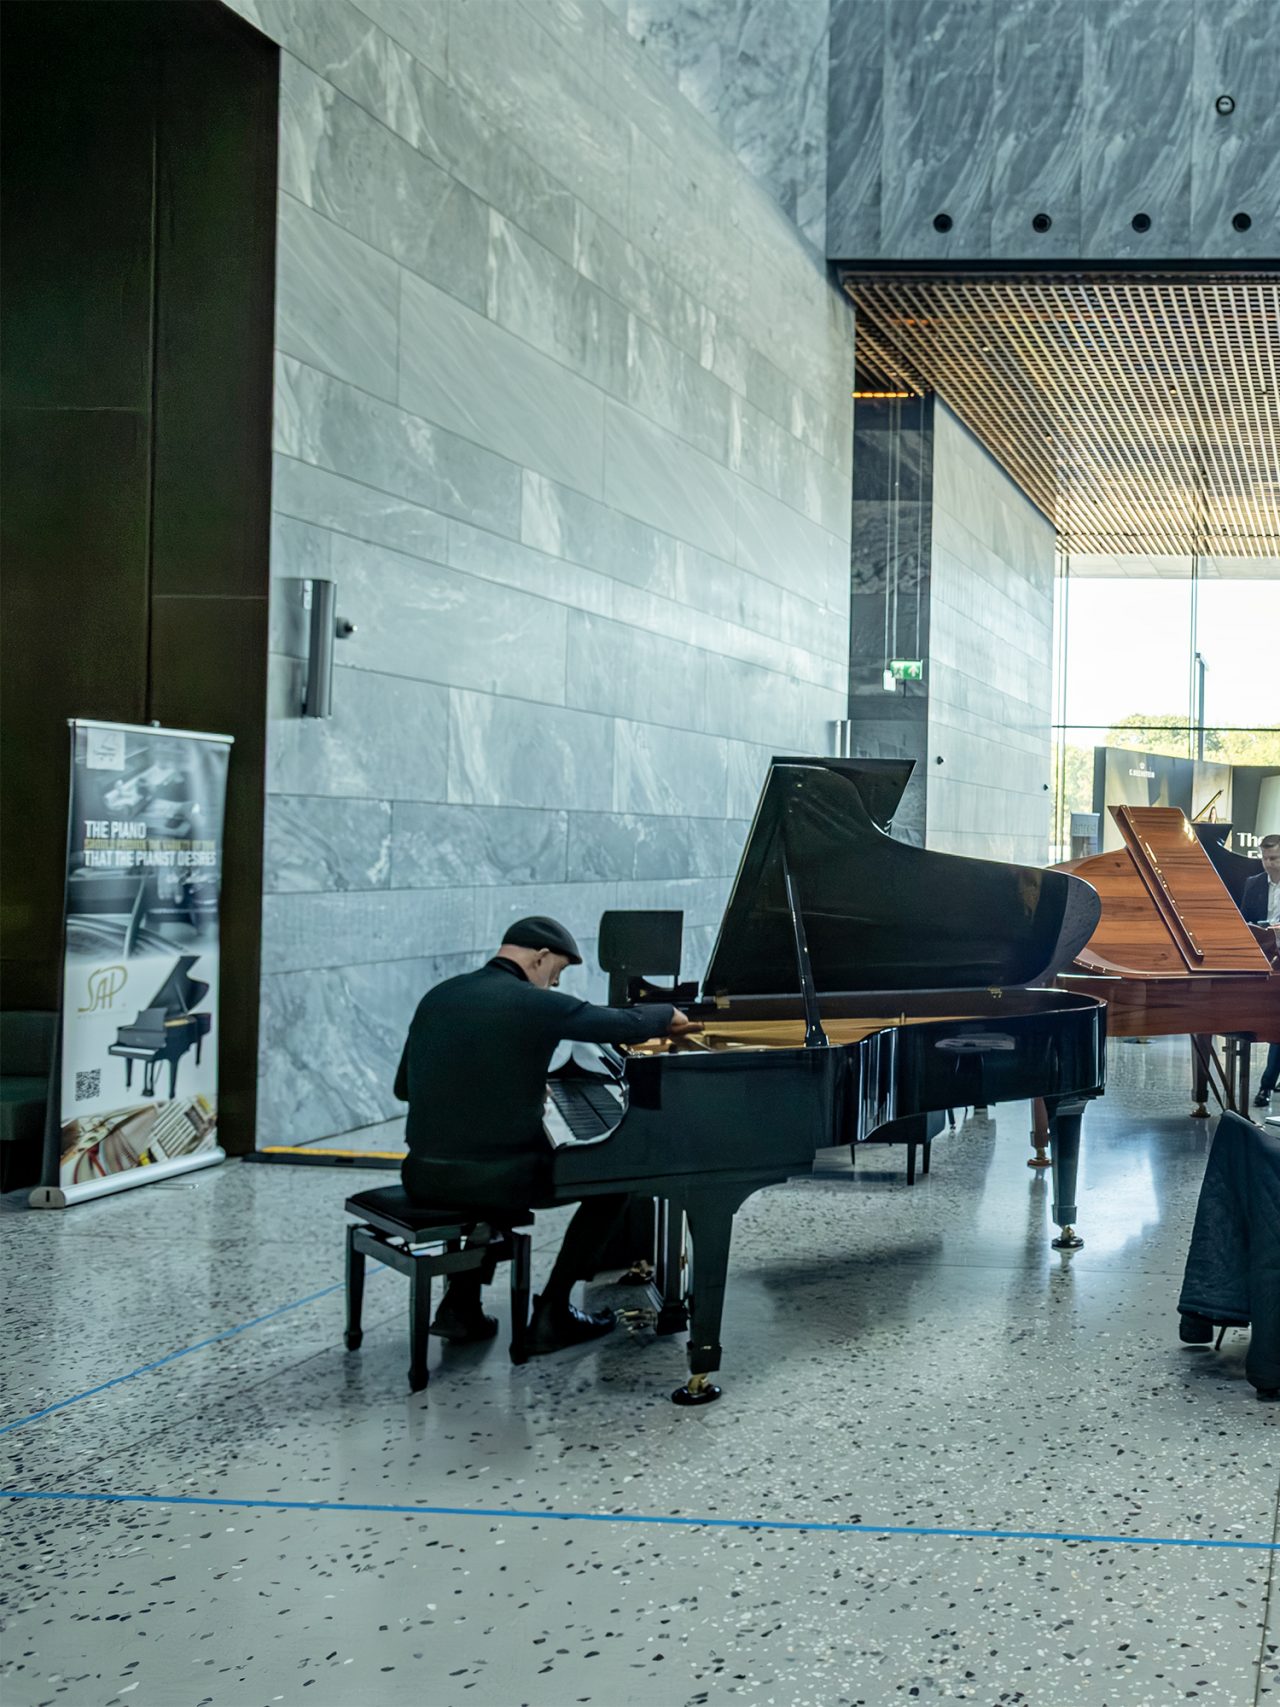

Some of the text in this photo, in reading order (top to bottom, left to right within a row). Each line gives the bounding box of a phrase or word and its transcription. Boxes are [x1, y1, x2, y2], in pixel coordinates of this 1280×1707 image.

[84, 820, 147, 839] THE PIANO
[84, 851, 113, 866] THAT
[115, 851, 134, 866] THE
